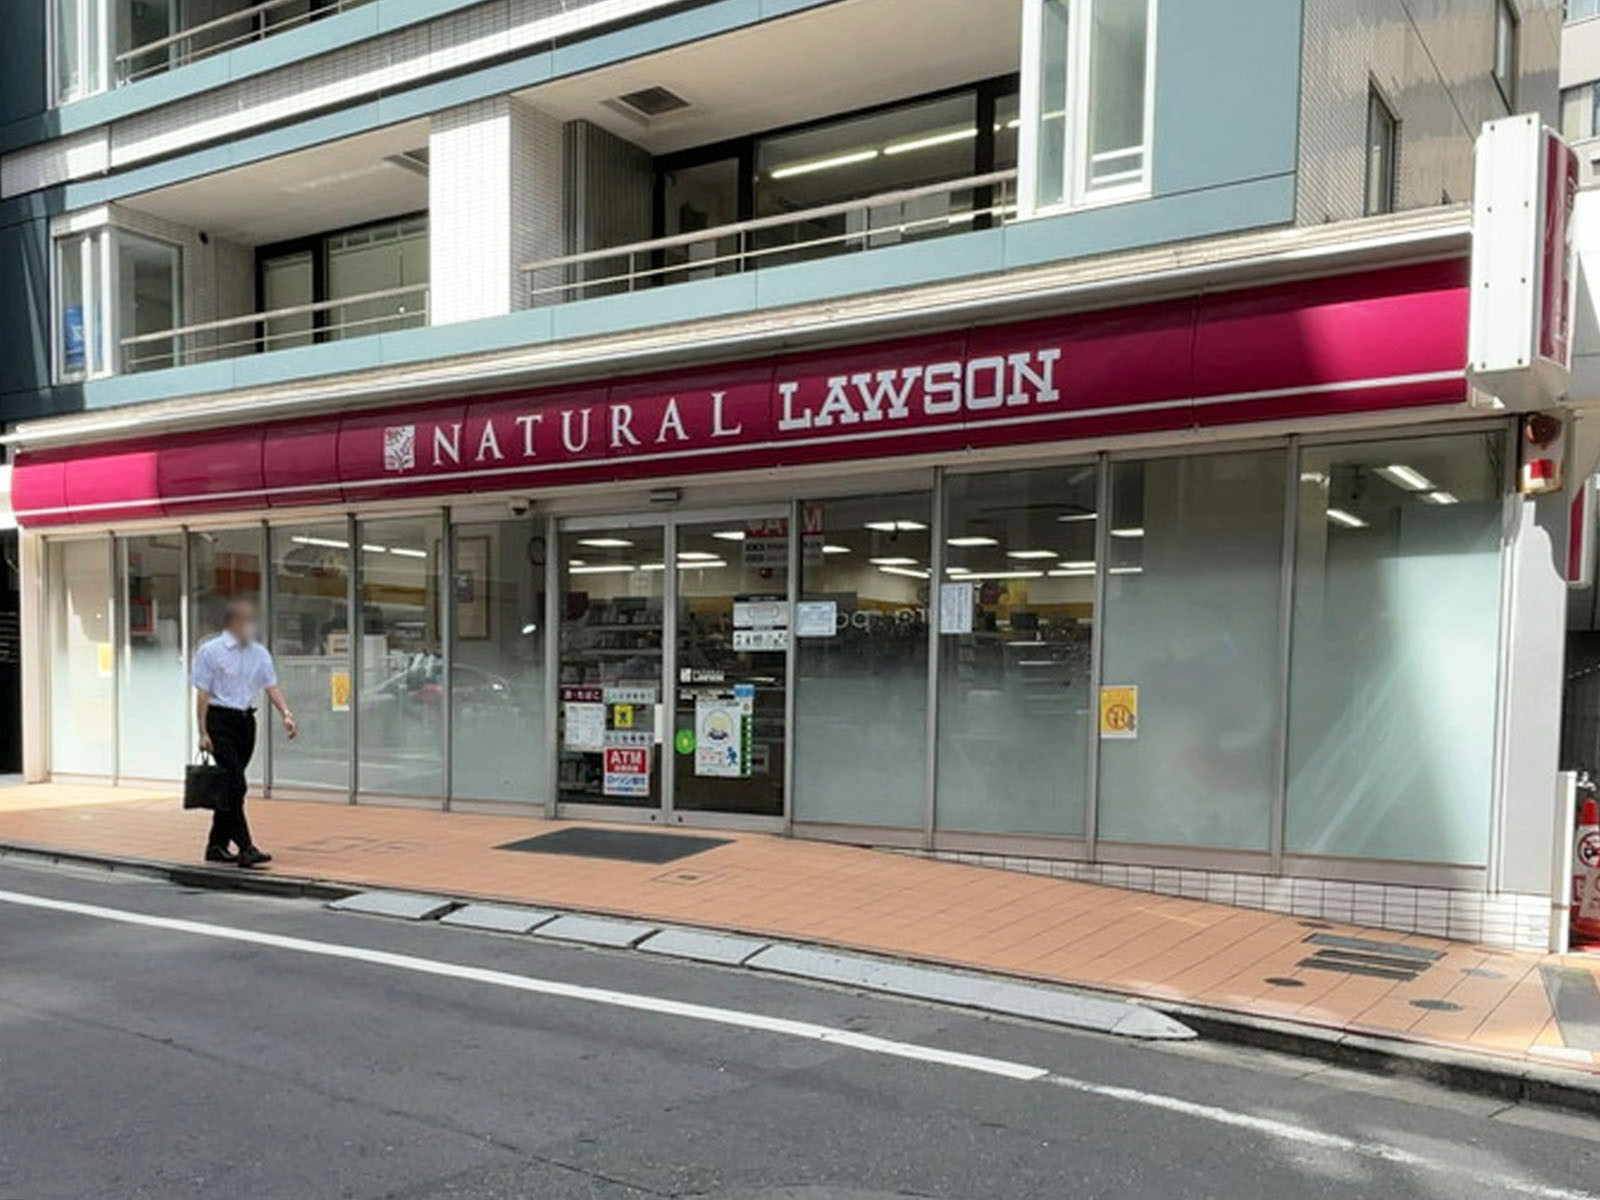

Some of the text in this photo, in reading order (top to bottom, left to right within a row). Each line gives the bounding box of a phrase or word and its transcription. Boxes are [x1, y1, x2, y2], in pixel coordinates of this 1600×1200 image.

[431, 348, 1063, 468] NATURAL LAWSON
[610, 750, 643, 765] ATM
